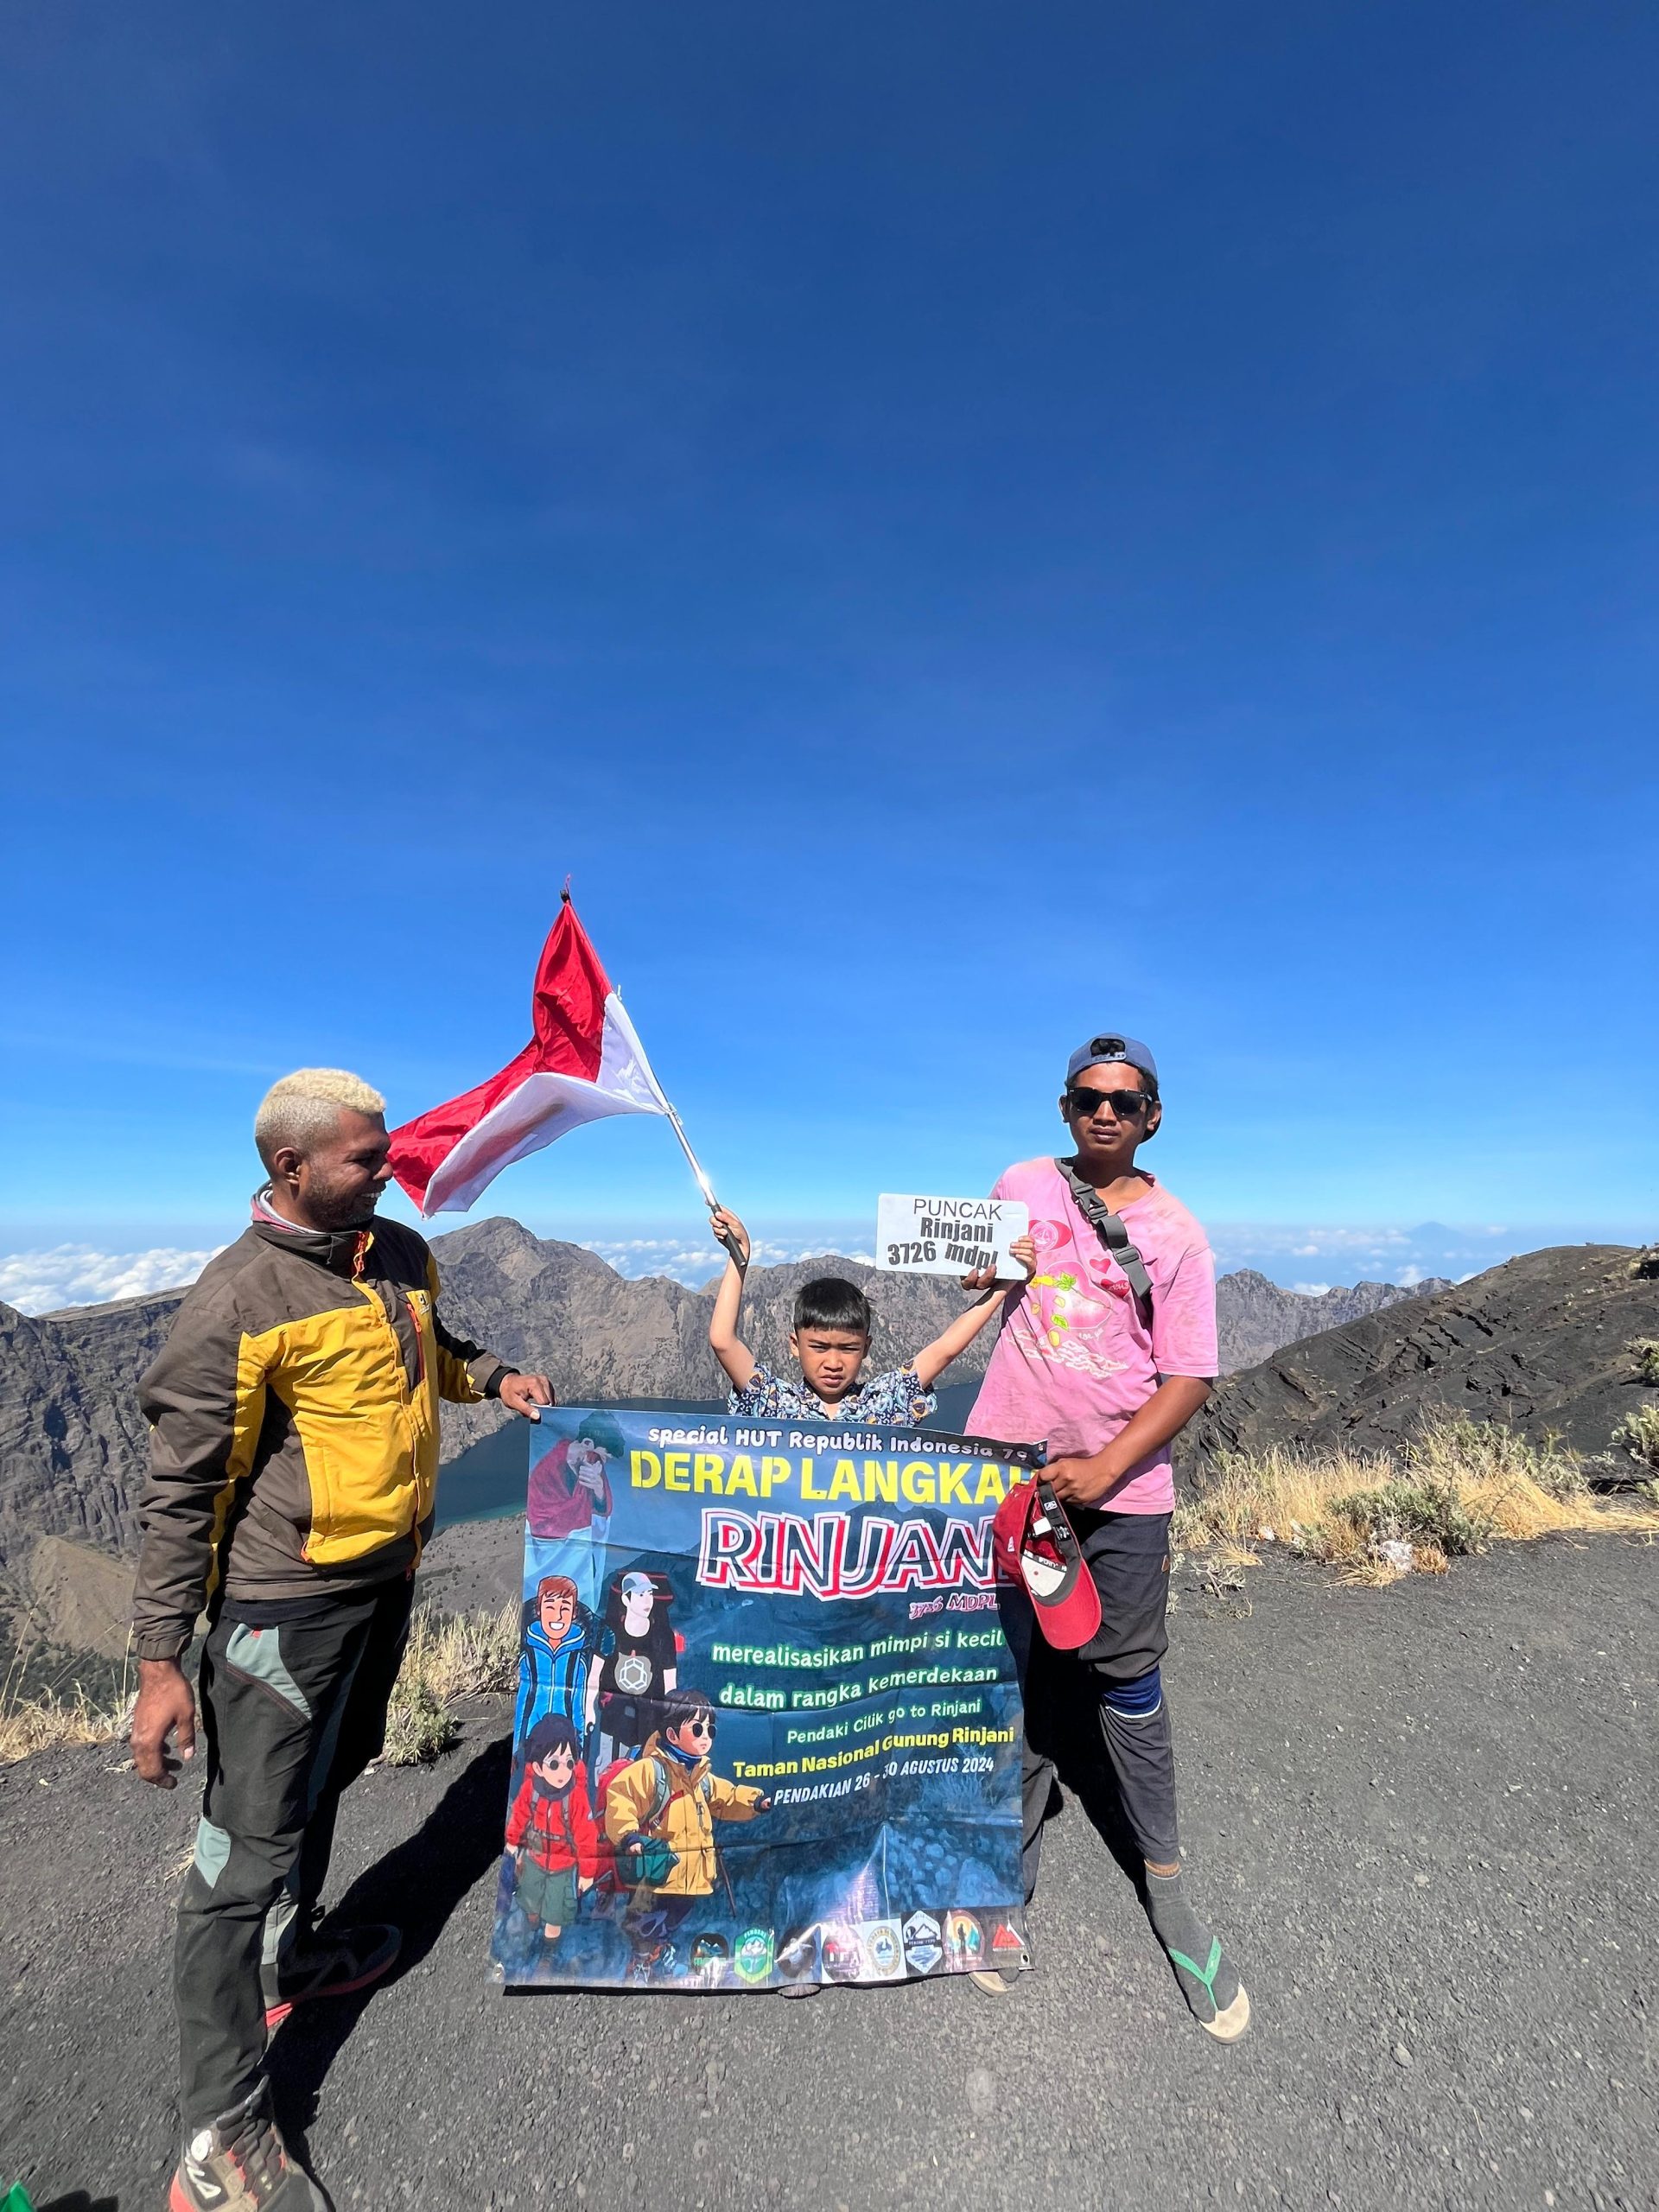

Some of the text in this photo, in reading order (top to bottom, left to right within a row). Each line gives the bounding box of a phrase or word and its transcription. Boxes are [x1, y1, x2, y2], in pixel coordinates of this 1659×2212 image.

[914, 1198, 1002, 1221] PUNCAK
[920, 1217, 994, 1243] Rinjani
[887, 1241, 999, 1270] 3726 mdpl
[648, 1425, 728, 1449] special
[735, 1428, 782, 1447] HUT
[789, 1431, 883, 1455] Republik
[890, 1436, 994, 1457] Indonesia
[630, 1450, 791, 1497] DERAP
[696, 1507, 1018, 1601] RINJAN
[946, 1592, 999, 1611] MDPL
[711, 1629, 1003, 1668] merealisasikan mimpi si kecil
[720, 1667, 997, 1708] dalam rangka kemerdekaan
[787, 1699, 982, 1744] Pendaki Cilik go to Rinjani
[733, 1726, 1014, 1778] Taman Nasional Gunung Rinjani
[773, 1777, 853, 1805] PENDAKIAN
[855, 1772, 871, 1792] 26
[900, 1758, 959, 1776] AGUSTUS
[962, 1757, 994, 1772] 2024
